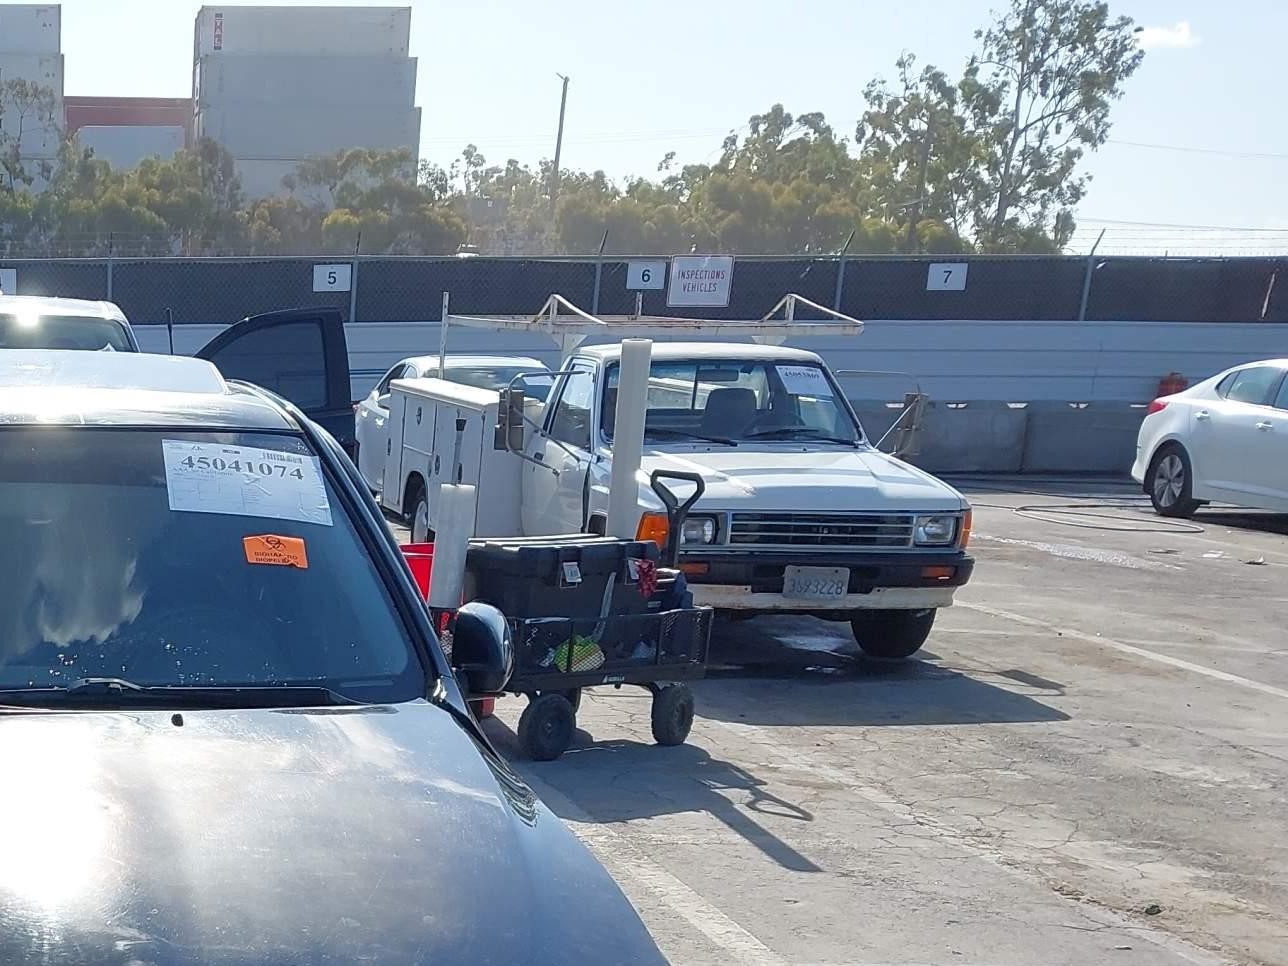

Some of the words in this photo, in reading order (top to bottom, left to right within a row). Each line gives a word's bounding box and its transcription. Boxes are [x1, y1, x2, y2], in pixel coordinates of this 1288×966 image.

[327, 271, 337, 285] 5
[641, 269, 651, 283] 6
[678, 269, 726, 281] INSPECTIONS
[943, 270, 953, 284] 7
[682, 282, 718, 293] VEHICLES
[181, 455, 305, 481] 45041074
